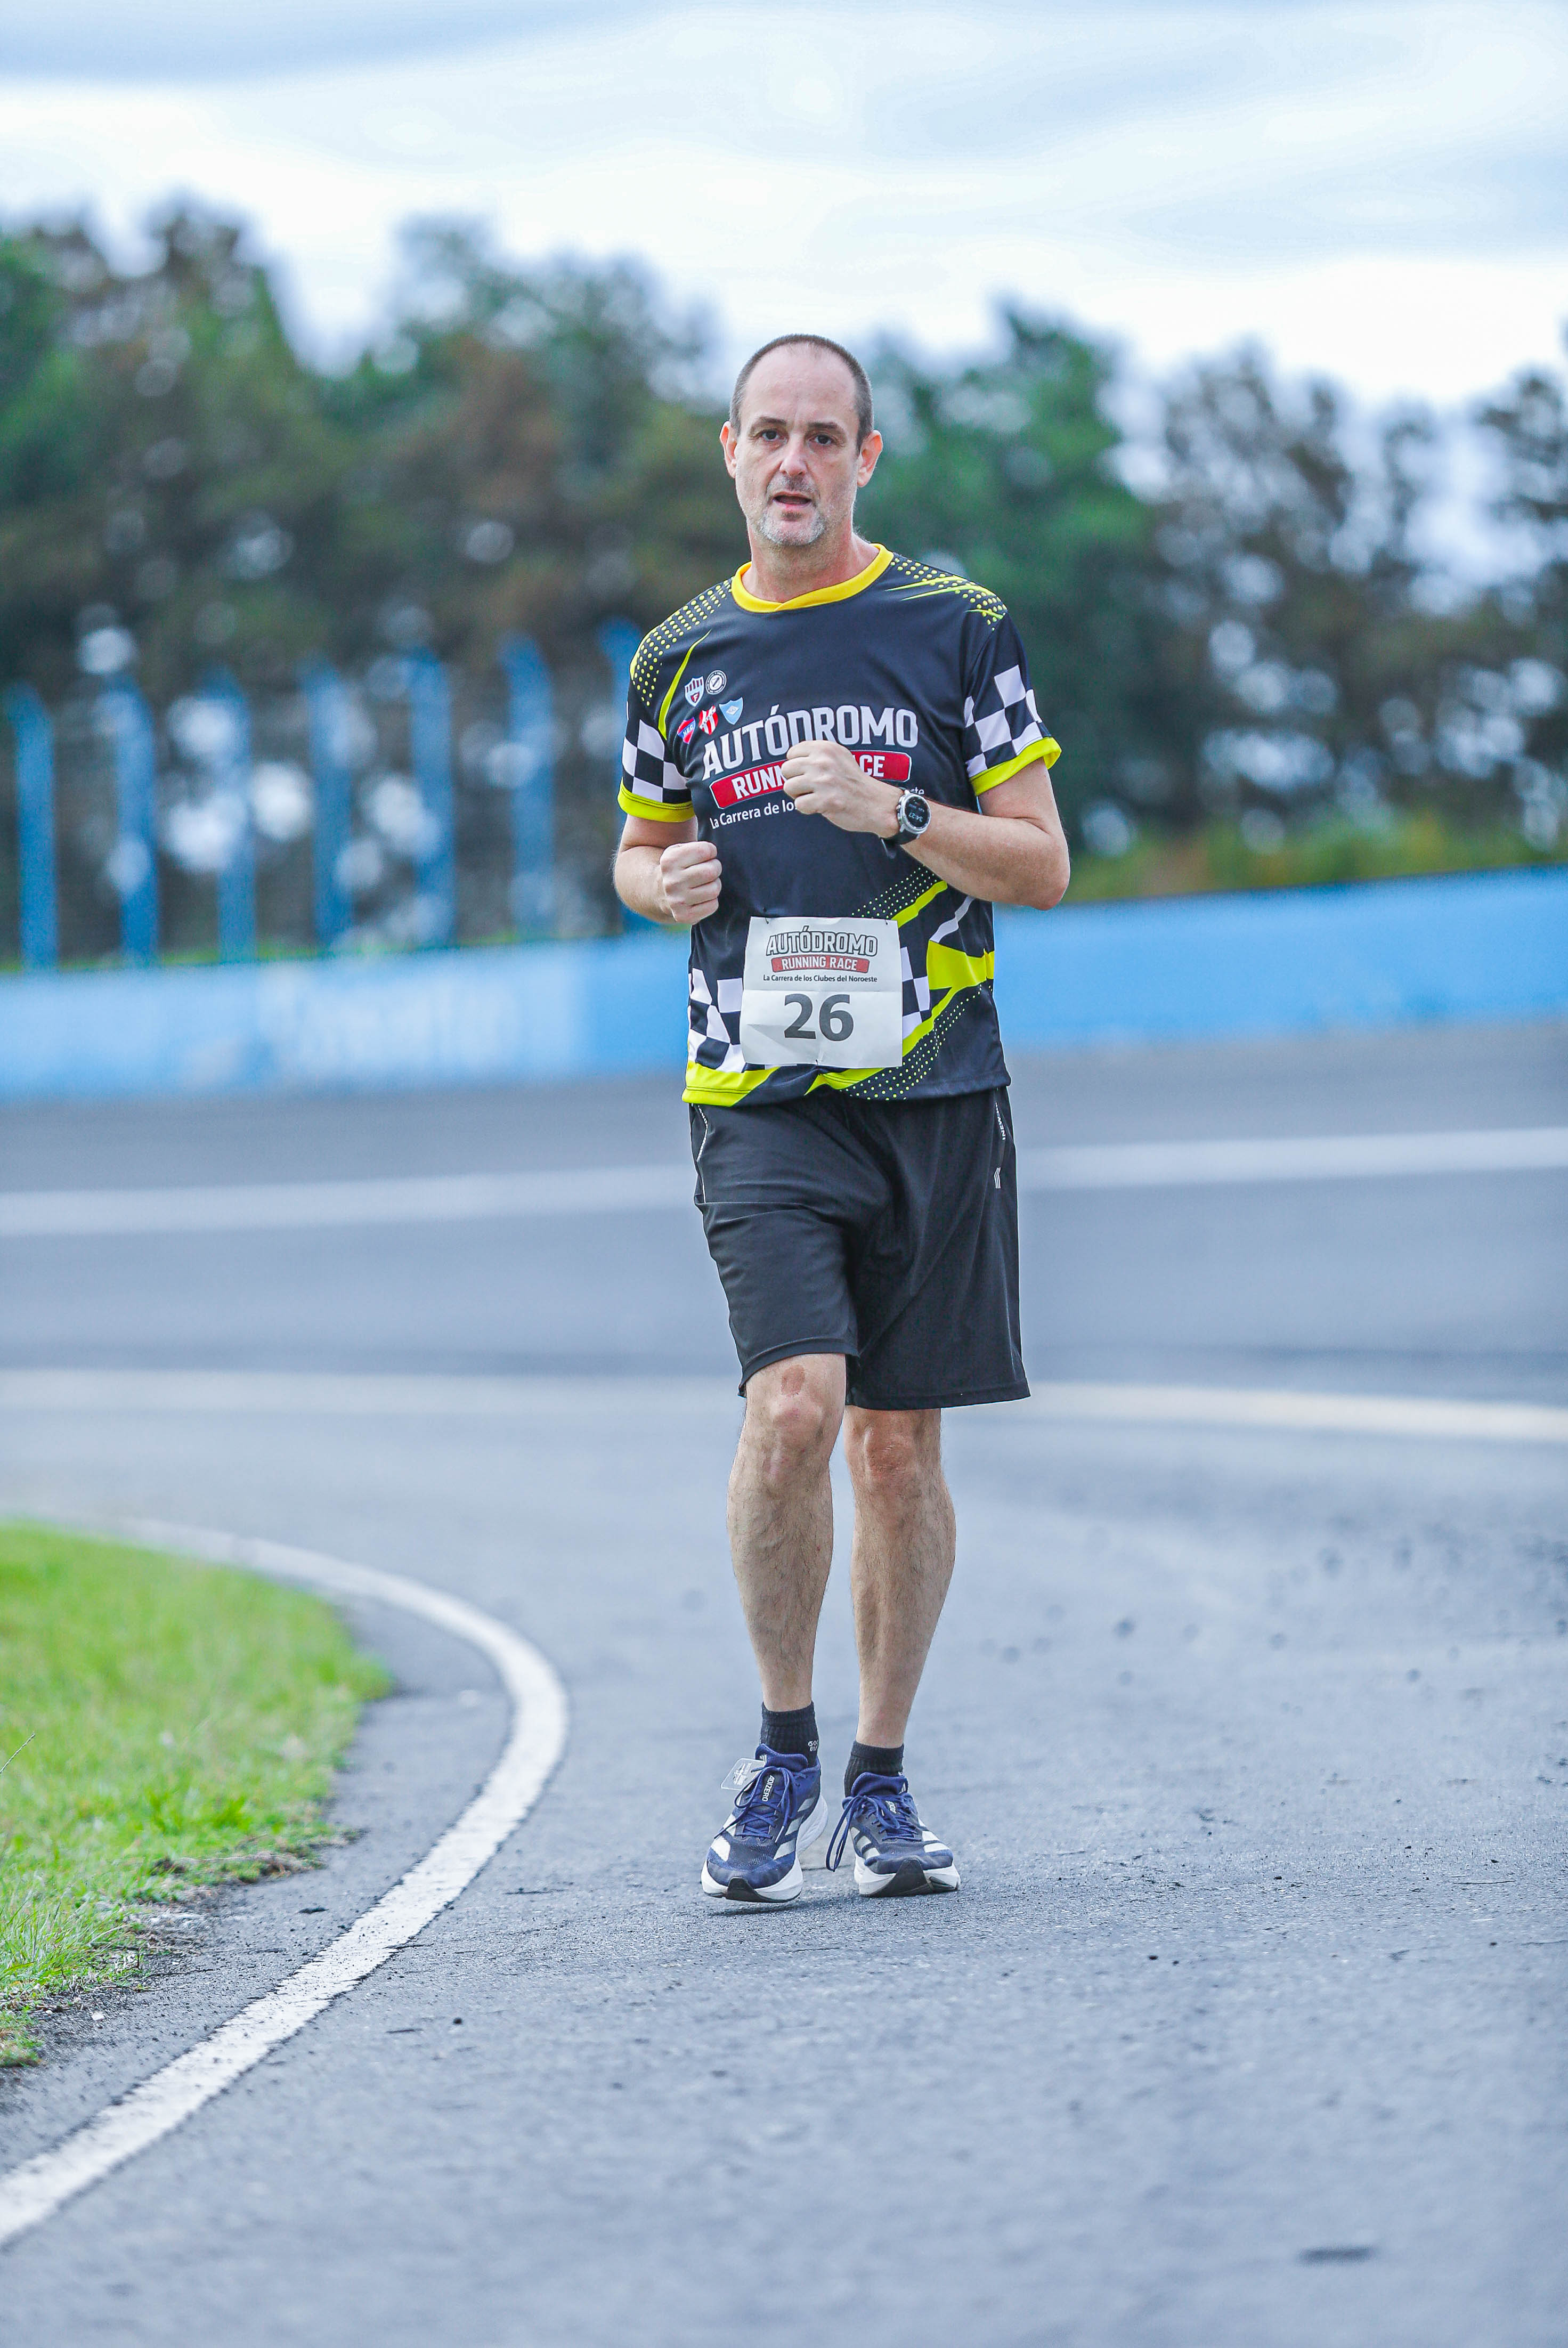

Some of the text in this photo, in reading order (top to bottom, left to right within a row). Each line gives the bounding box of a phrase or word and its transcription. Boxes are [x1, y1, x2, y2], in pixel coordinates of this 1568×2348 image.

[702, 704, 918, 781] AUTÓDROMO
[731, 754, 885, 799] RUNN CE
[719, 808, 761, 826] Carrera
[763, 802, 779, 816] de
[782, 799, 798, 813] lo
[766, 925, 878, 957] AUTÓDROMO
[781, 956, 858, 971] RUNNING RACE
[784, 993, 854, 1042] 26
[761, 1775, 775, 1802] ADIZERO
